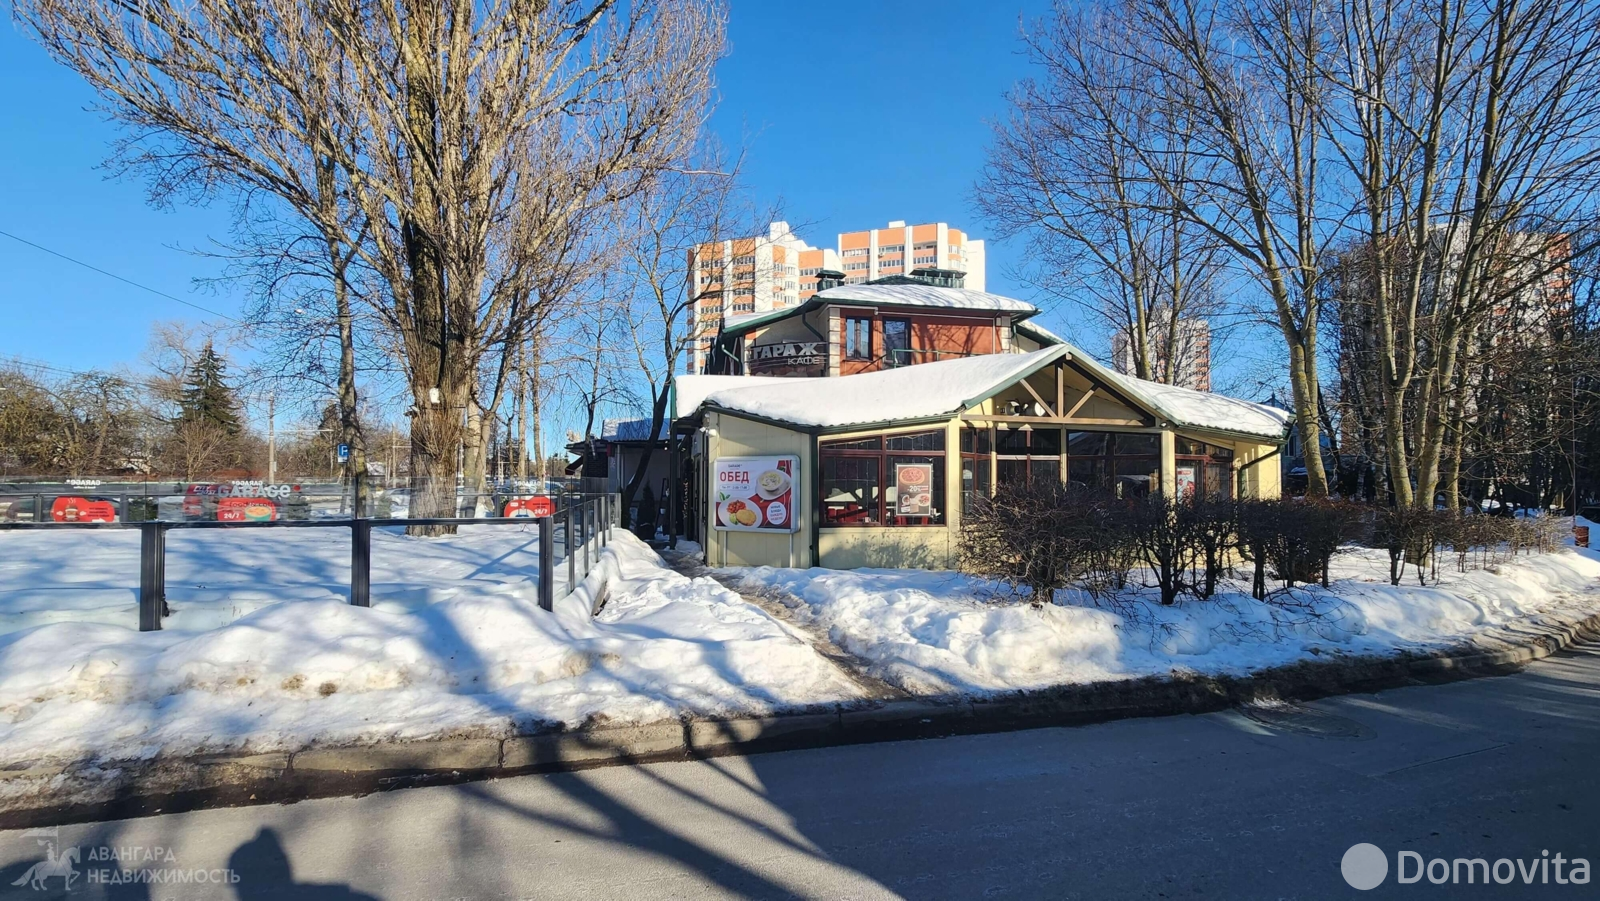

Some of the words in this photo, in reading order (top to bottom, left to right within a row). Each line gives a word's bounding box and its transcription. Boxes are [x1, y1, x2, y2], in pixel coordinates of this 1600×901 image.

[753, 342, 820, 360] ГАРАЖ
[787, 356, 820, 365] КАФЕ
[720, 471, 750, 484] ОБЕД
